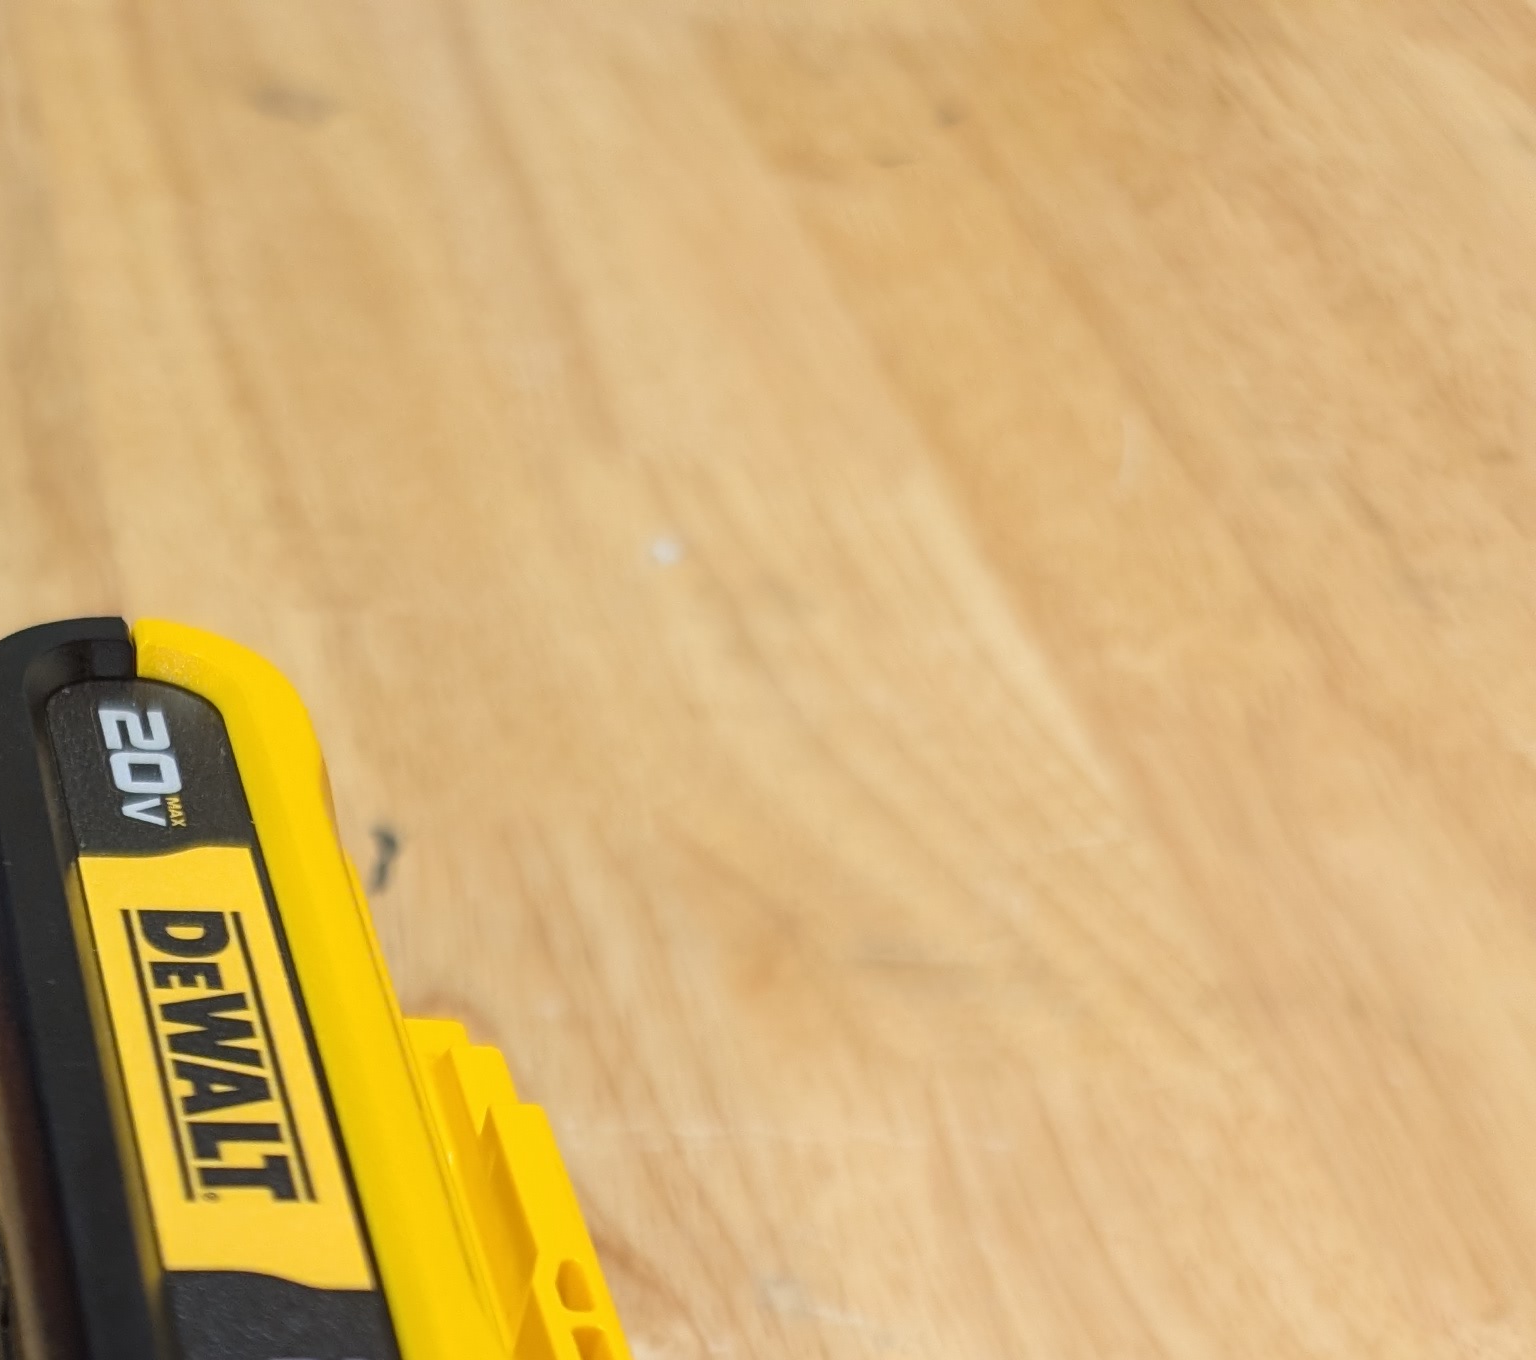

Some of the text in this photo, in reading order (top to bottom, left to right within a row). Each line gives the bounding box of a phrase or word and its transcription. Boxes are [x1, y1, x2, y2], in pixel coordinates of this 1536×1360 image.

[98, 709, 187, 828] 20V MAX
[136, 909, 300, 1202] DEWALT
